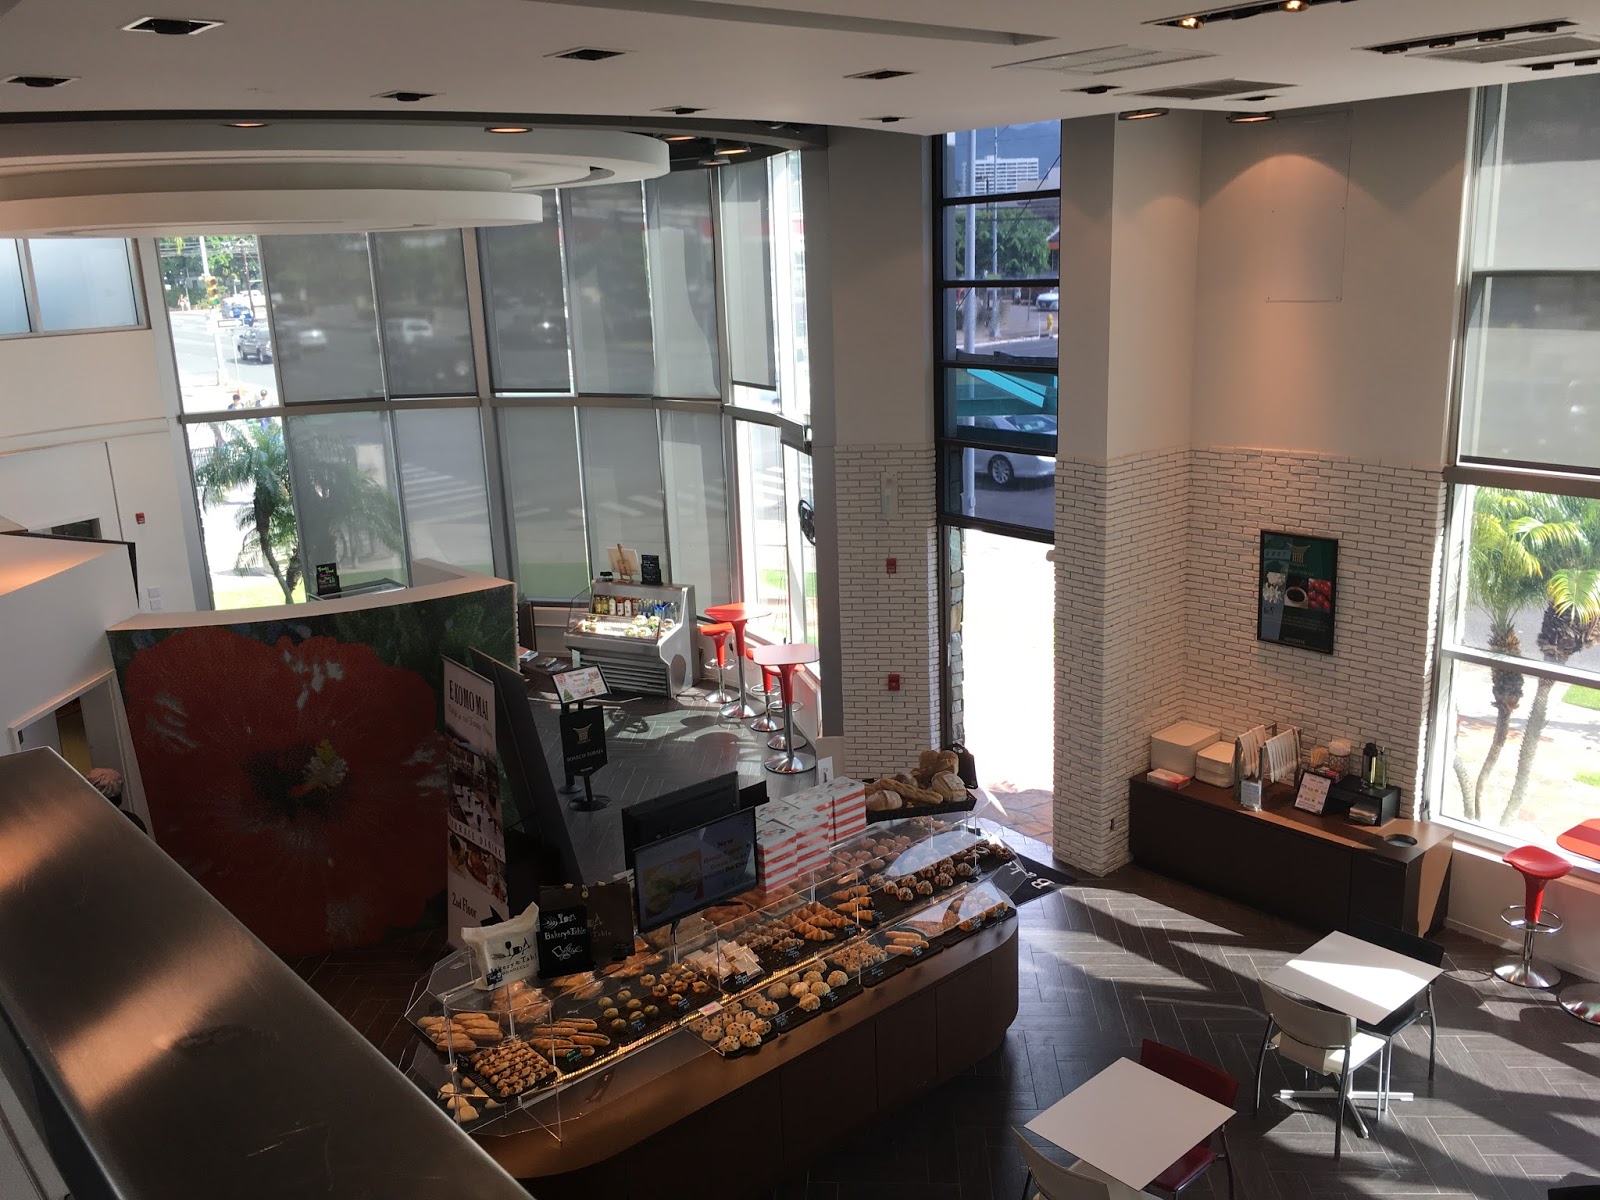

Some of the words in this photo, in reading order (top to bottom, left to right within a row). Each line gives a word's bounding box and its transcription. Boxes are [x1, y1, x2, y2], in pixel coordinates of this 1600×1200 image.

[454, 682, 475, 712] KOMO
[475, 694, 489, 721] MAI
[452, 891, 462, 909] 2nd
[461, 897, 477, 920] Floor
[520, 953, 538, 963] Tabl
